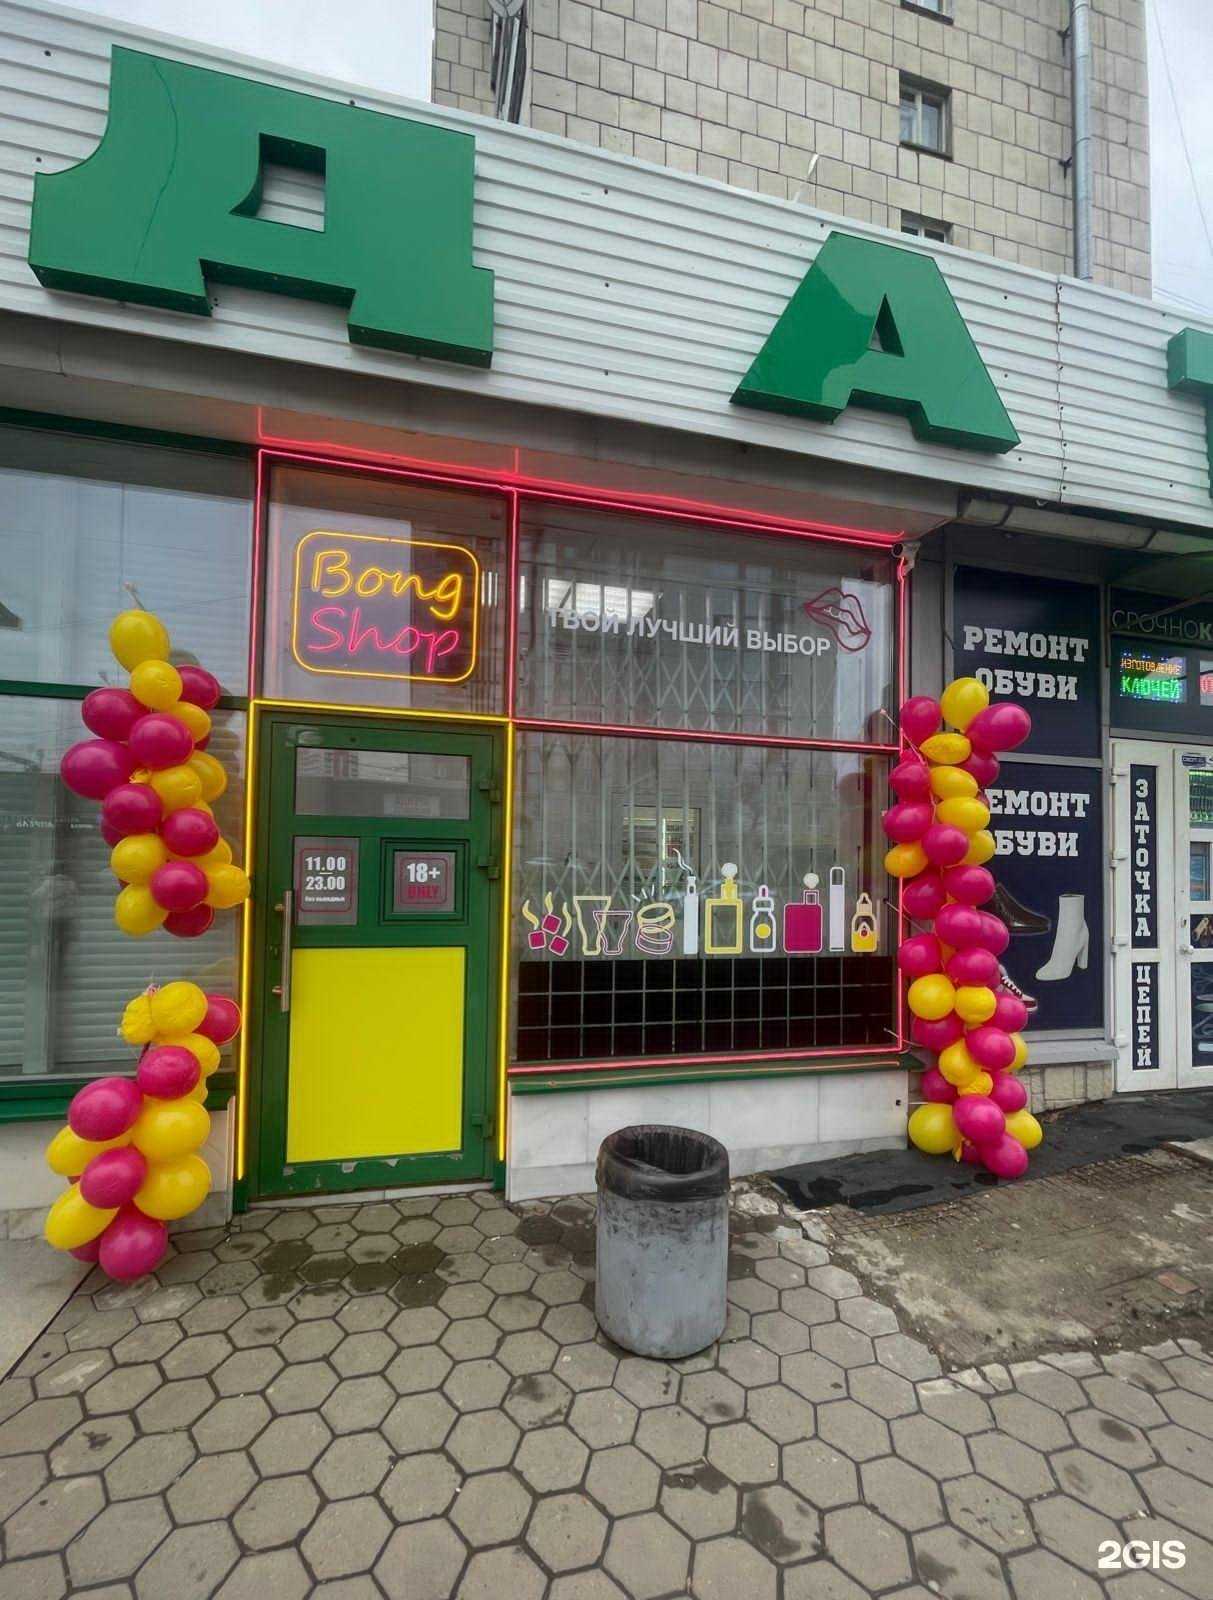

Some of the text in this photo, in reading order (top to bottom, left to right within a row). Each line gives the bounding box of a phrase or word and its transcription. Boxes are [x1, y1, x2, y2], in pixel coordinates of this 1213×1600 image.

[312, 550, 463, 621] Bong
[307, 606, 460, 674] Shop
[547, 607, 831, 657] ТВОЙ ЛУЧШИЙ ВЫБОР
[963, 625, 1089, 663] РЕМОНТ
[975, 667, 1078, 701] ОБУВИ
[1122, 676, 1180, 698] КЛЮЧЕЙ
[984, 788, 1090, 818] ЕМОНТ
[986, 829, 1079, 857] БУВИ
[1135, 778, 1151, 937] ЗАТОЧКА
[305, 856, 346, 872] 11.00
[407, 863, 441, 883] 18+
[305, 876, 346, 891] 23.00
[1136, 965, 1151, 1067] ЦЕПЕЙ
